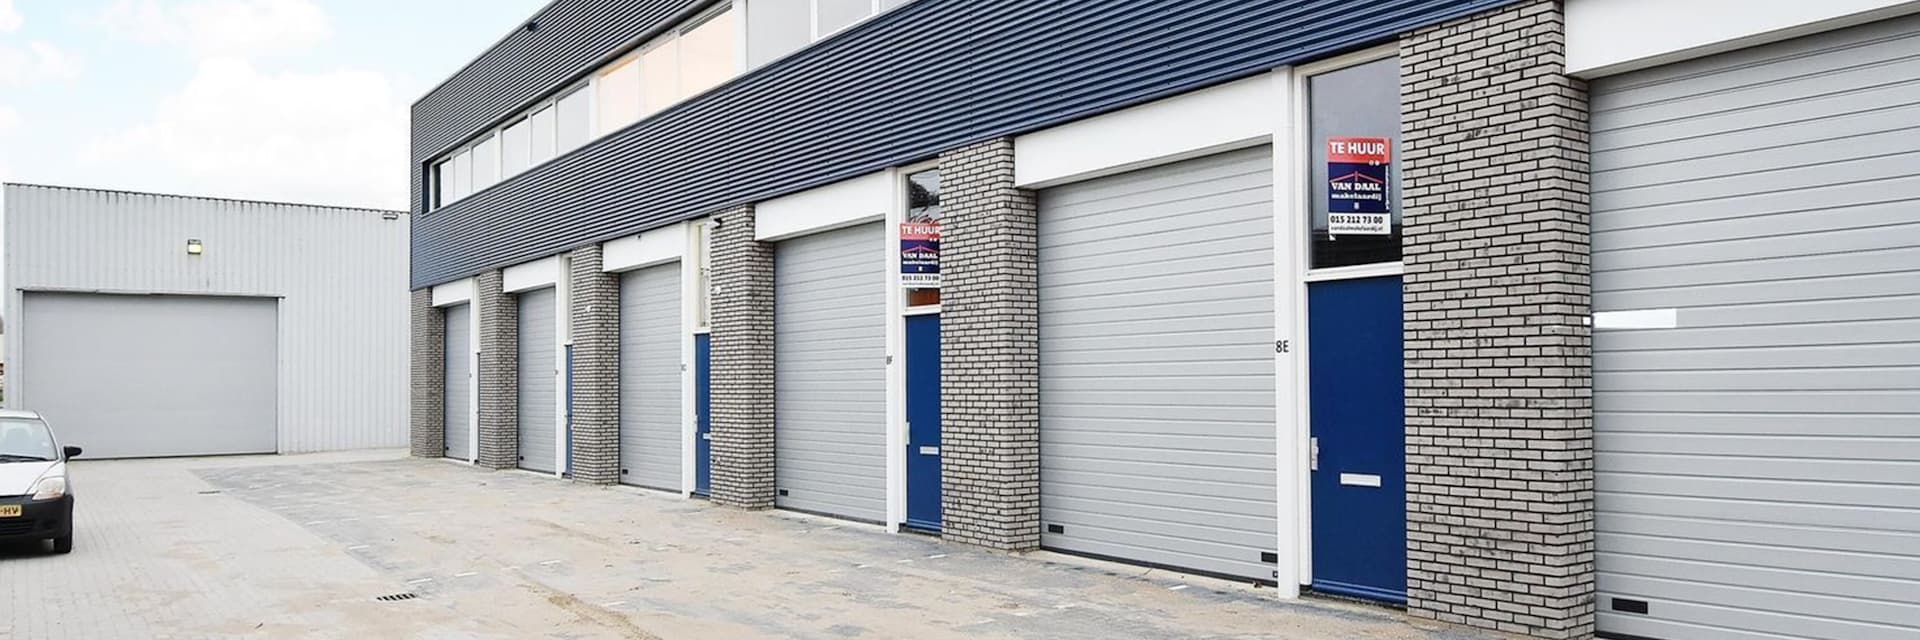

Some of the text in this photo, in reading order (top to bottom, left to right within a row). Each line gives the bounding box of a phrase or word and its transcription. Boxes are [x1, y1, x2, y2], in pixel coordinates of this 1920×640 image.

[1330, 142, 1385, 155] TE HUUR
[1331, 182, 1381, 191] VAN DAAL
[1331, 192, 1382, 201] makelaardij
[1330, 215, 1384, 224] 015 212 73 00
[902, 225, 911, 235] TE
[1275, 340, 1289, 353] 8E
